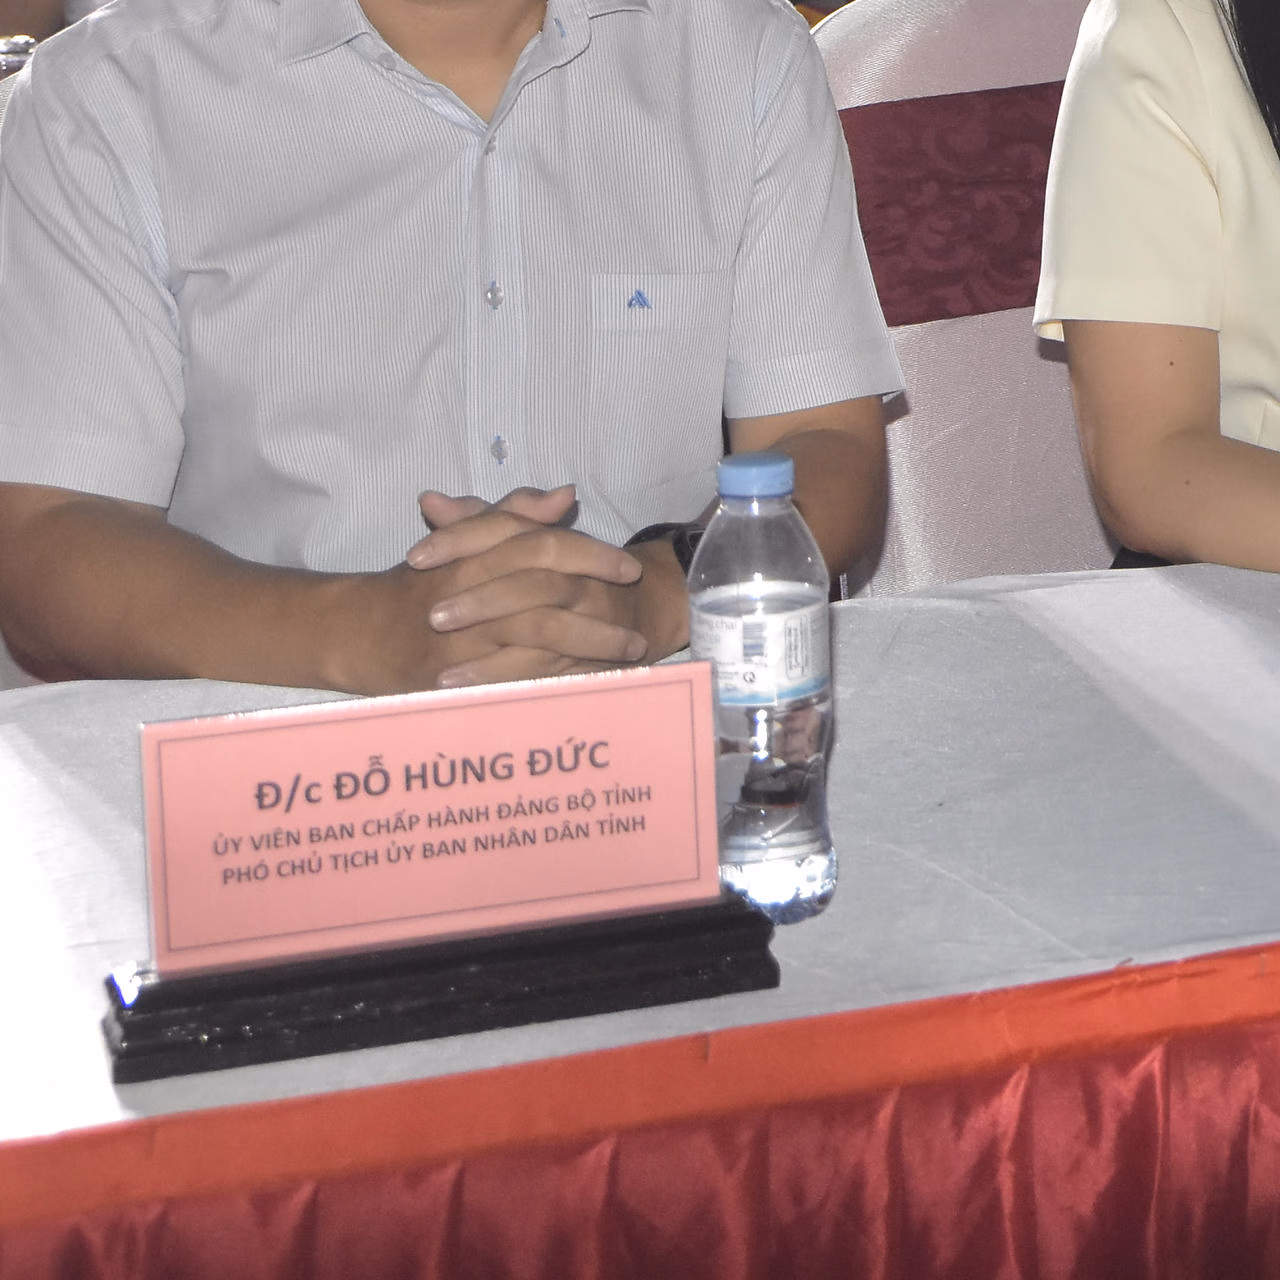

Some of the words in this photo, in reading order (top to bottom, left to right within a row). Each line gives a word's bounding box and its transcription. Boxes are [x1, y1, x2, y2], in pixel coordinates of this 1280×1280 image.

[254, 773, 322, 814] Đ/c
[333, 754, 391, 801] ĐỖ
[404, 752, 514, 792] HÙNG
[526, 736, 611, 777] ĐỨC
[213, 832, 243, 856] ỦY
[250, 827, 301, 852] VIÊN
[309, 822, 355, 844] BAN
[362, 808, 420, 837] CHẤP
[427, 804, 490, 829] HÀNH
[496, 795, 560, 820] ĐẢNG
[567, 788, 597, 812] BỘ
[602, 782, 652, 807] TỈNH
[222, 859, 270, 885] PHÓ
[277, 851, 323, 878] CHỦ
[330, 850, 379, 874] TỊCH
[387, 840, 415, 864] ỦY
[423, 838, 466, 859] BAN
[474, 826, 537, 852] NHÂN
[544, 820, 590, 844] DÂN
[597, 812, 646, 837] TỈNH
